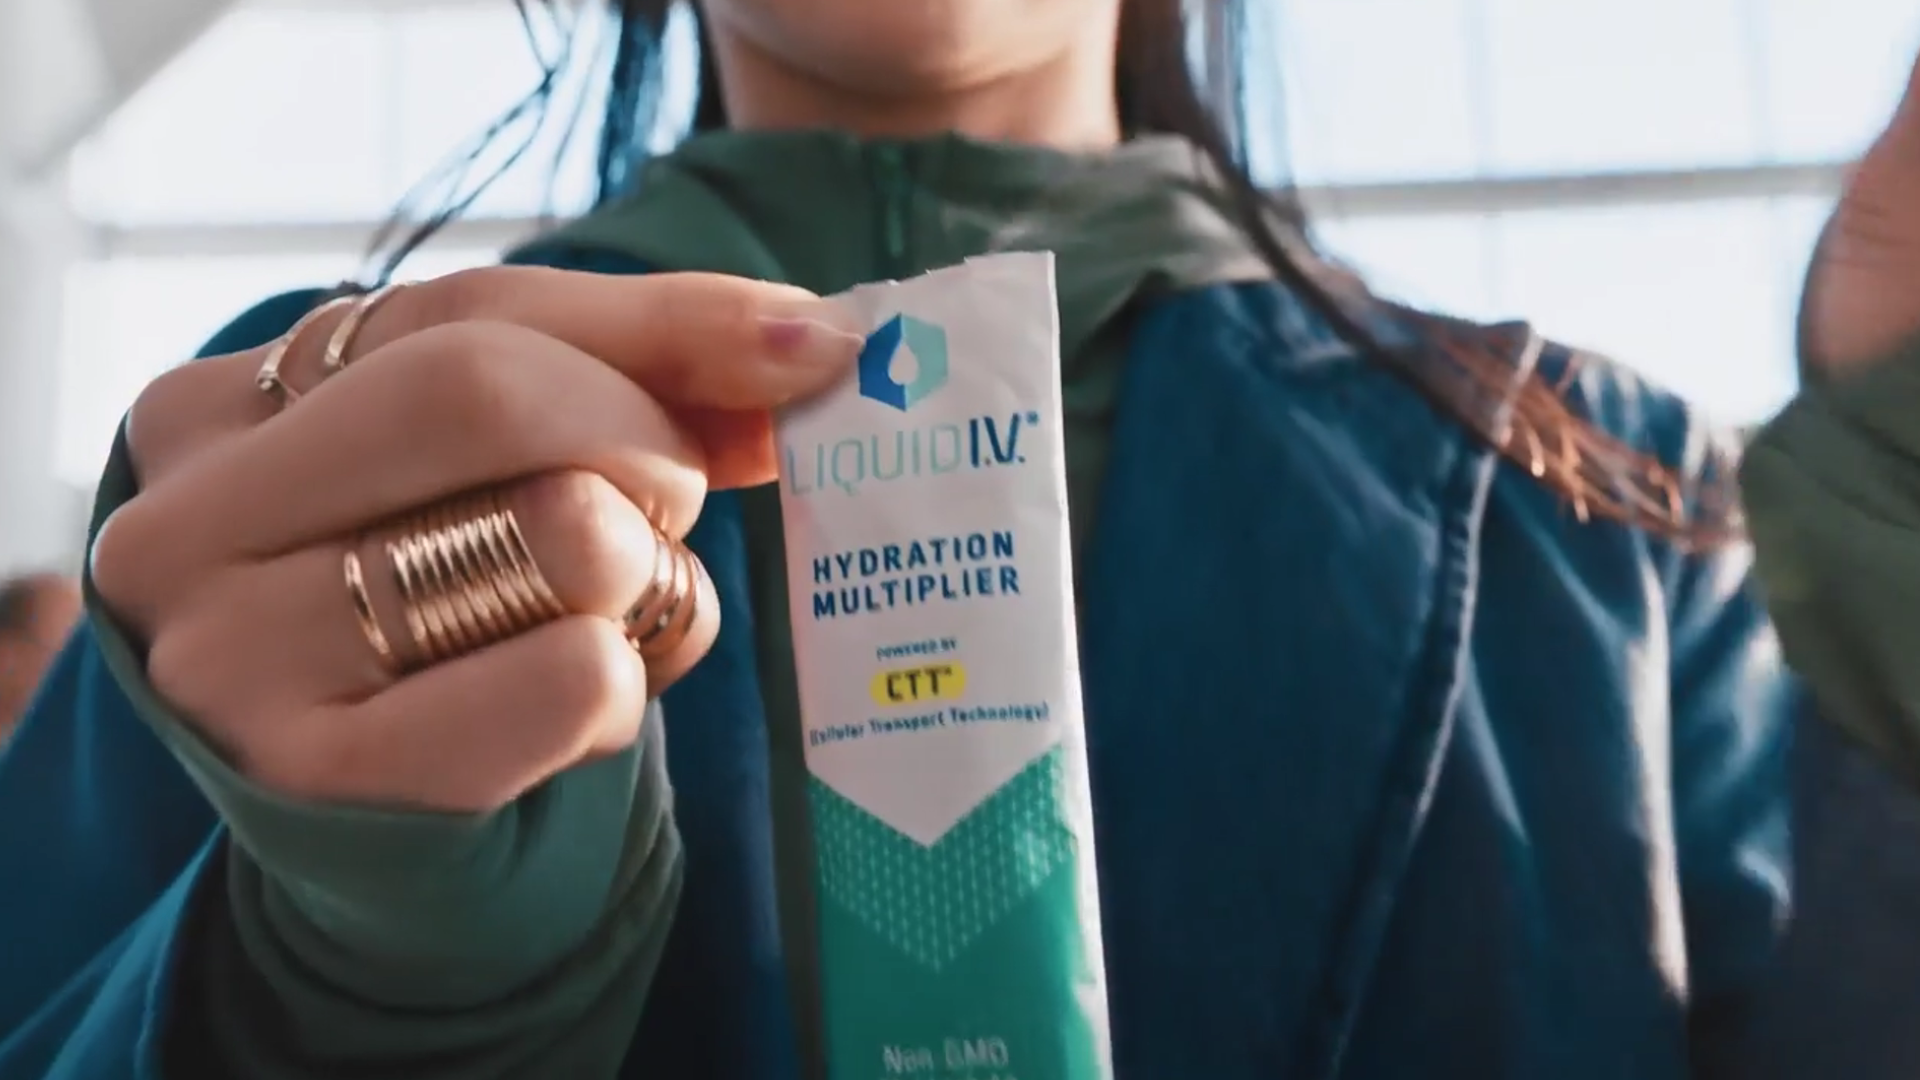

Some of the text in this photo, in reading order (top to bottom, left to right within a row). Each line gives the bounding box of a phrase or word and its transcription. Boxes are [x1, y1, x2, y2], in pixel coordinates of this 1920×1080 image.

[786, 424, 962, 496] LIQUID
[812, 530, 1015, 584] HYDRATION
[812, 565, 1020, 621] MULTIPLIER
[868, 713, 946, 735] Transport
